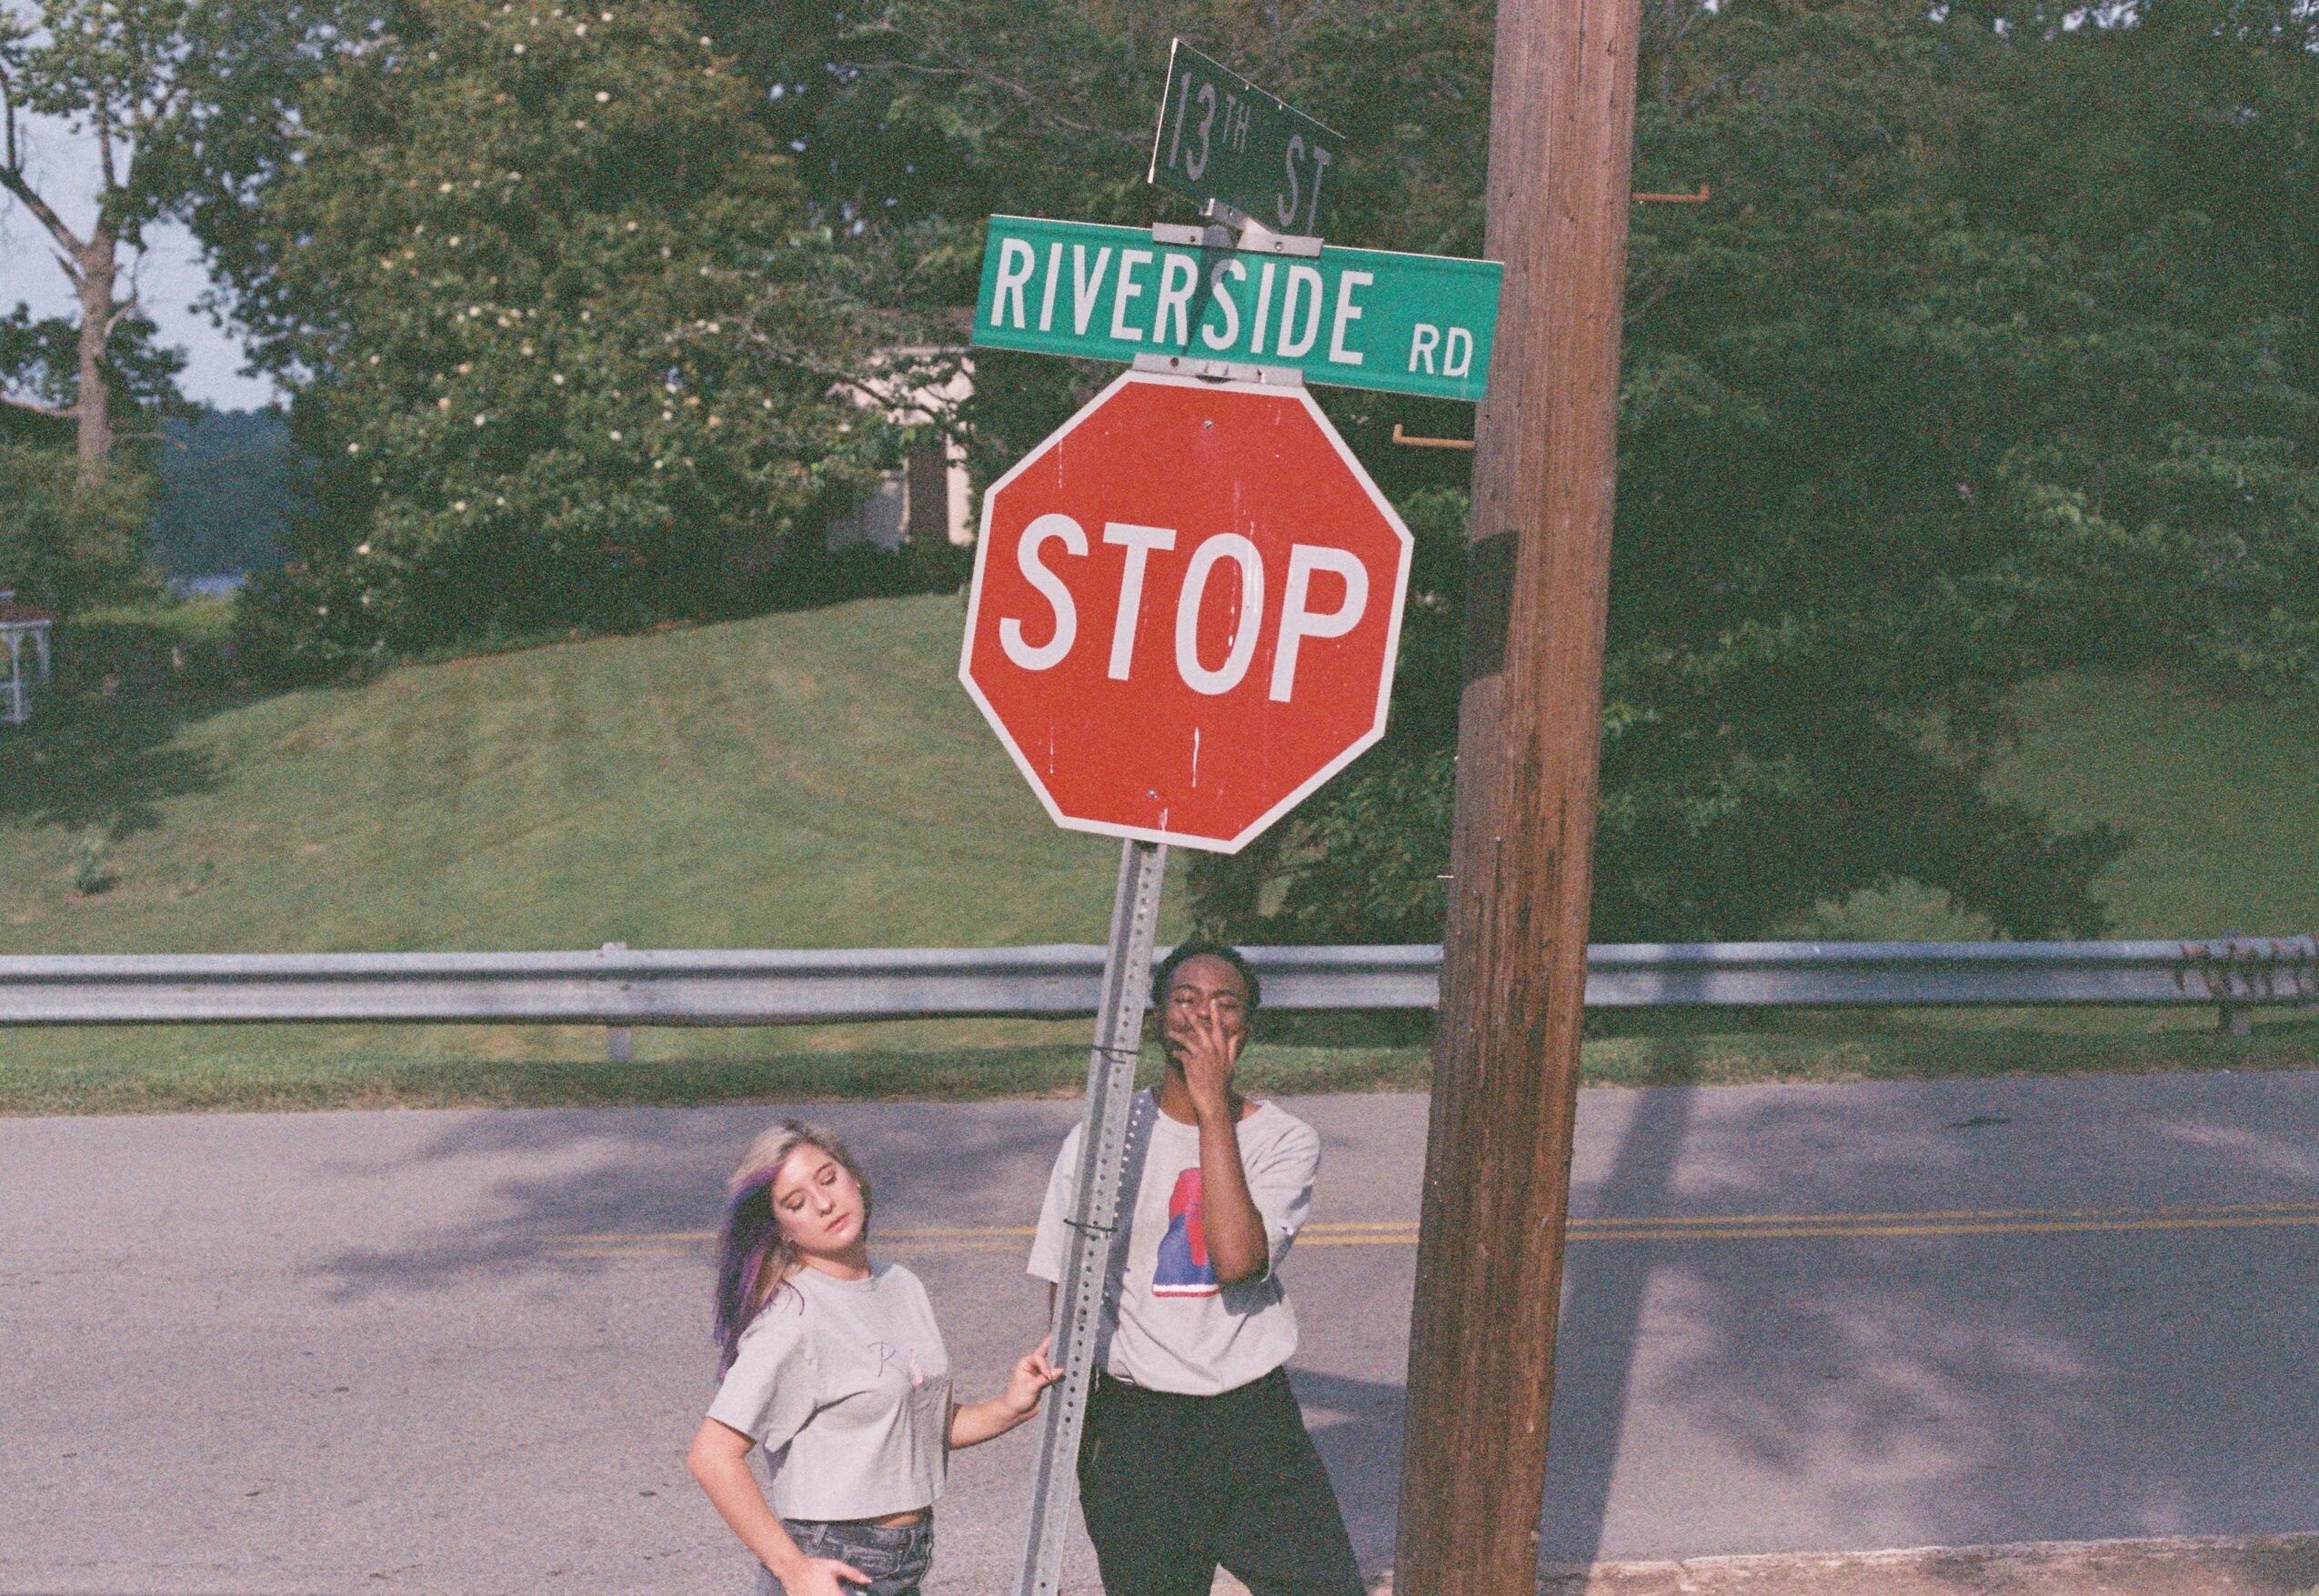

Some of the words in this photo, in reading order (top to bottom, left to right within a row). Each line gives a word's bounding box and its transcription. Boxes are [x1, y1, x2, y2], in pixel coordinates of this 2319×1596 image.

[1169, 73, 1250, 180] 13TH
[1277, 136, 1330, 234] ST
[990, 238, 1373, 365] RIVERSIDE
[1409, 324, 1474, 377] RD
[999, 513, 1369, 702] STOP
